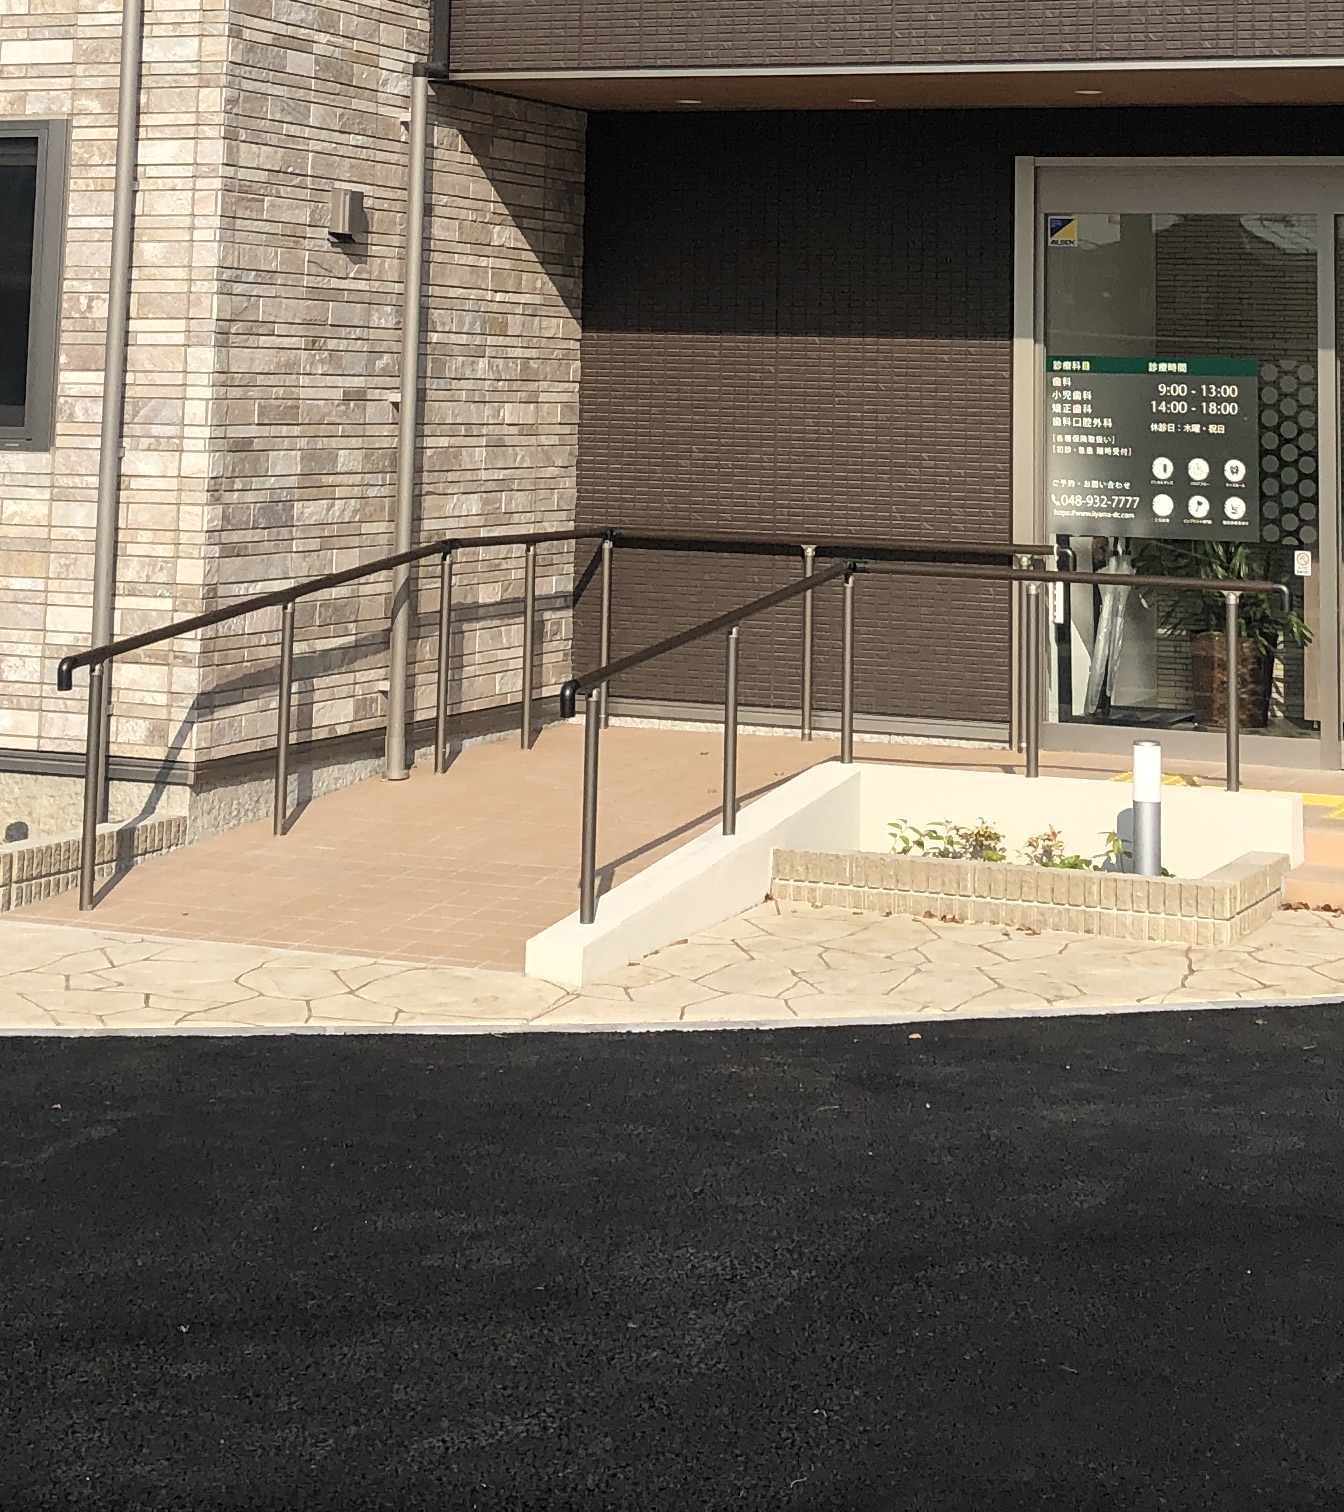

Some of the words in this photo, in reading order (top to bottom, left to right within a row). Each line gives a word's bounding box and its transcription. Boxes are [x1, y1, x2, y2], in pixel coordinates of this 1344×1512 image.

[1052, 360, 1091, 371] 診療科目
[1148, 362, 1187, 373] 診療時間
[1052, 376, 1072, 387] 歯科
[1052, 390, 1093, 401] 小児歯科
[1158, 384, 1188, 397] 9:00
[1200, 384, 1239, 398] 13:00
[1052, 403, 1093, 415] 矯正歯科
[1150, 400, 1188, 414] 14:00
[1200, 402, 1239, 415] 18:00
[1052, 417, 1113, 428] 歯科口腔外科
[1061, 493, 1140, 509] 048-932-7777
